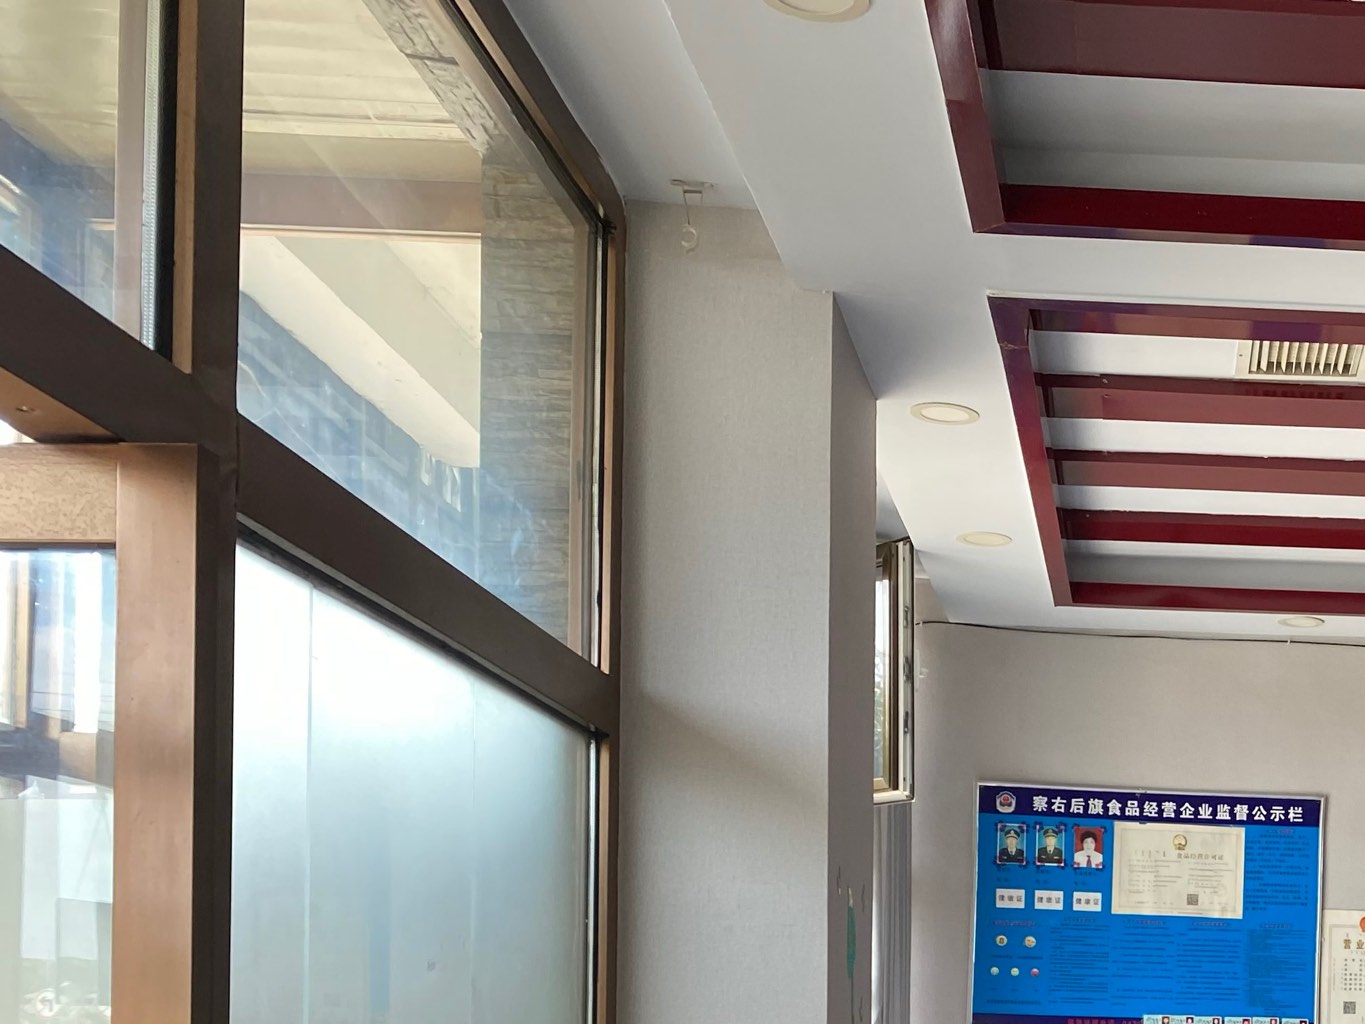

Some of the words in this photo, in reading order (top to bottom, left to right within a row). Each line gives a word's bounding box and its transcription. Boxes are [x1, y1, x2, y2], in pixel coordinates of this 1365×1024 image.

[1032, 795, 1304, 822] 察右后旗食品经营企业监督公示栏
